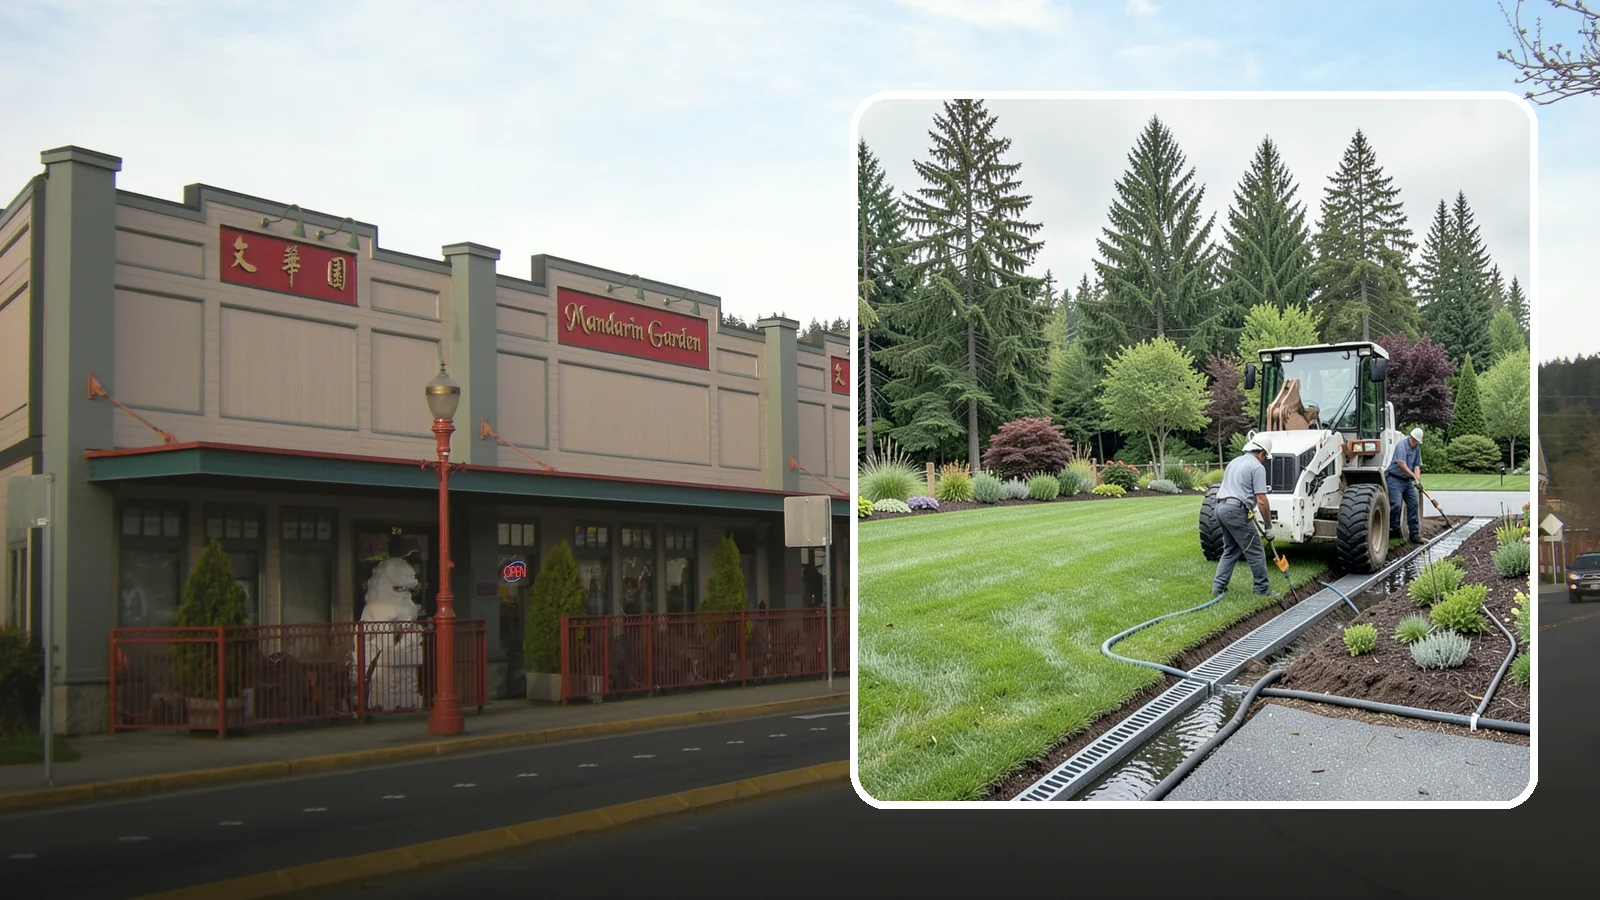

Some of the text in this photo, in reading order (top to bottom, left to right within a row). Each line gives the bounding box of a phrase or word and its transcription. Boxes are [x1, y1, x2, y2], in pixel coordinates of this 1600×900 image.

[231, 236, 346, 290] 文華園
[564, 302, 701, 352] Mandarin Garden
[503, 565, 527, 578] OPEN
